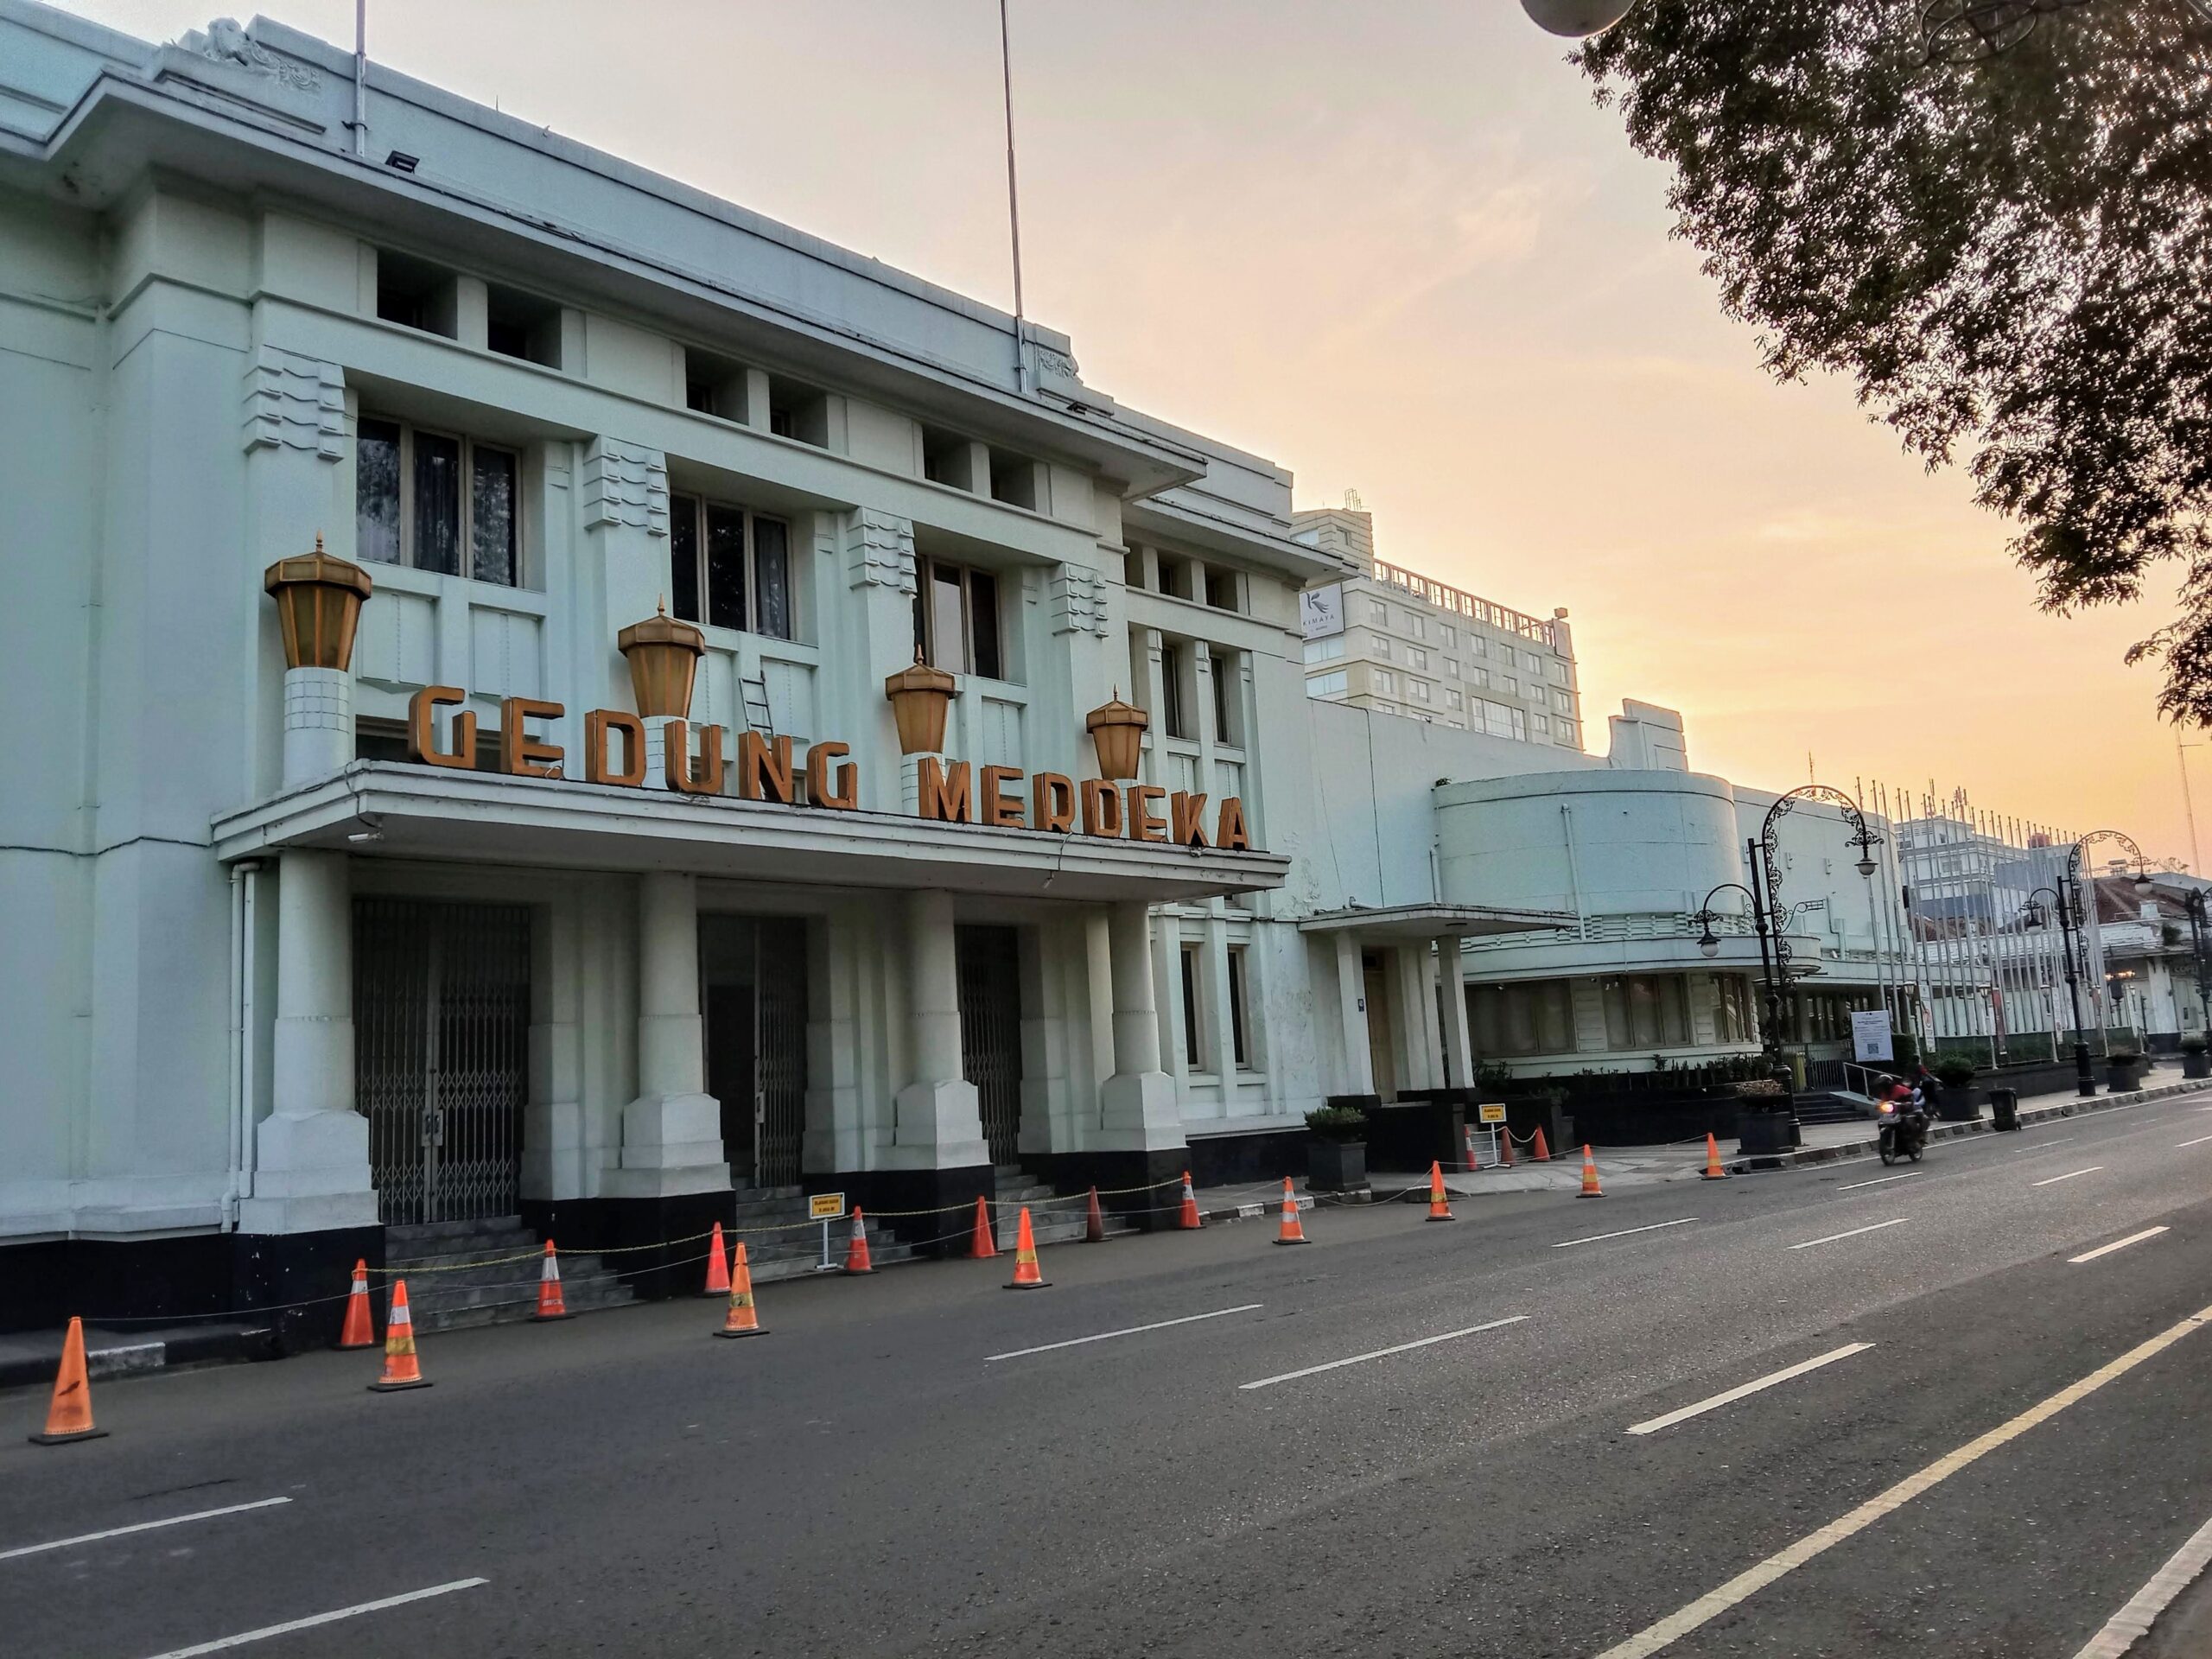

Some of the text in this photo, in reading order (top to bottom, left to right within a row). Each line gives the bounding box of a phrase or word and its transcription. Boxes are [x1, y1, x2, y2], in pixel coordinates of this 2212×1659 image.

[1303, 614, 1335, 626] KIMAYA
[409, 686, 1250, 849] GEDUNG MERDEKA
